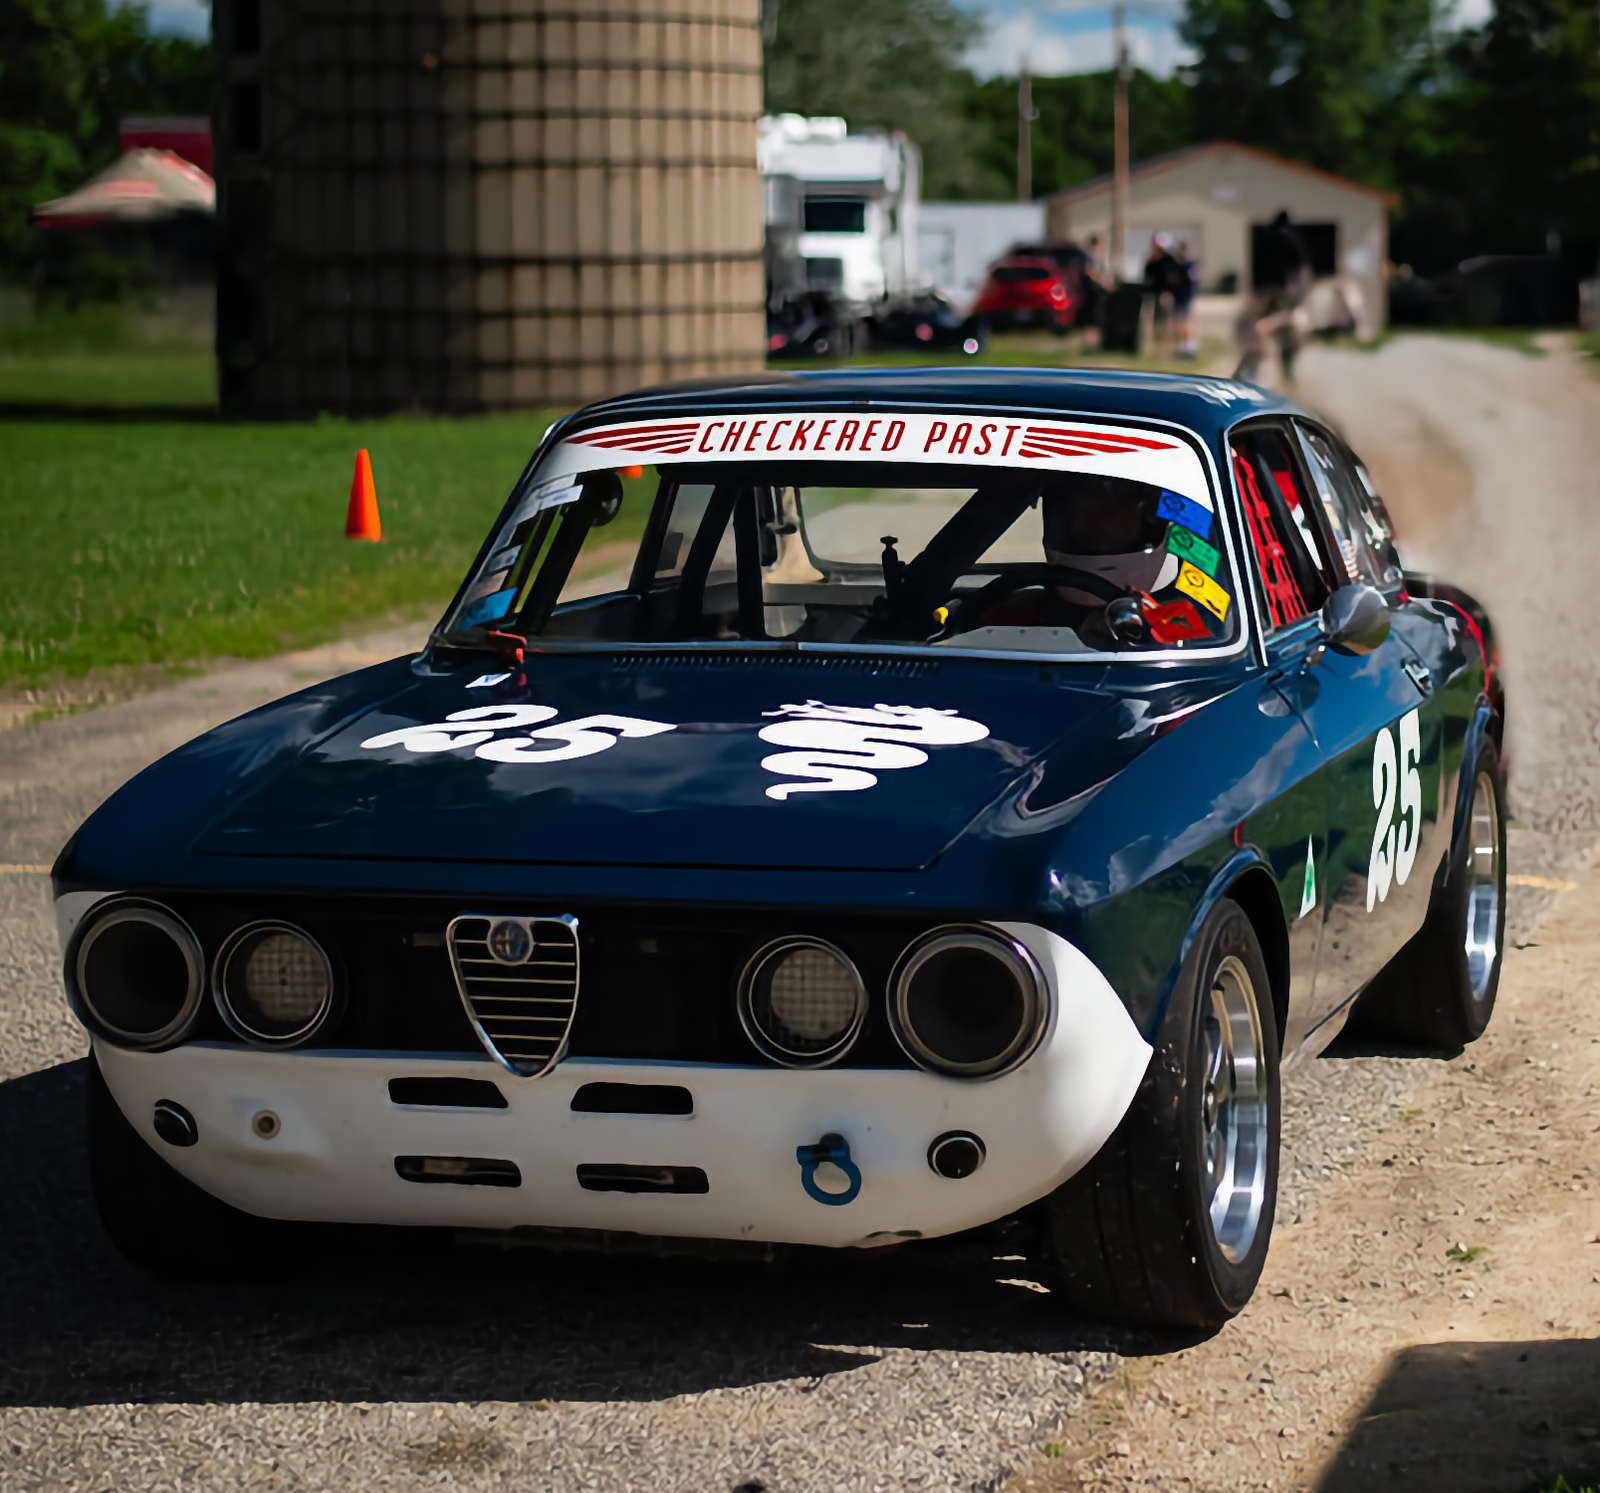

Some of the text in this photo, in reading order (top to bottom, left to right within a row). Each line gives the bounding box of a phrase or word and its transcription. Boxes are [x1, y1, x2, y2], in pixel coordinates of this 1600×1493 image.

[698, 419, 1021, 456] CHECKERED PAST
[360, 703, 678, 764] 25
[1366, 708, 1422, 913] 25
